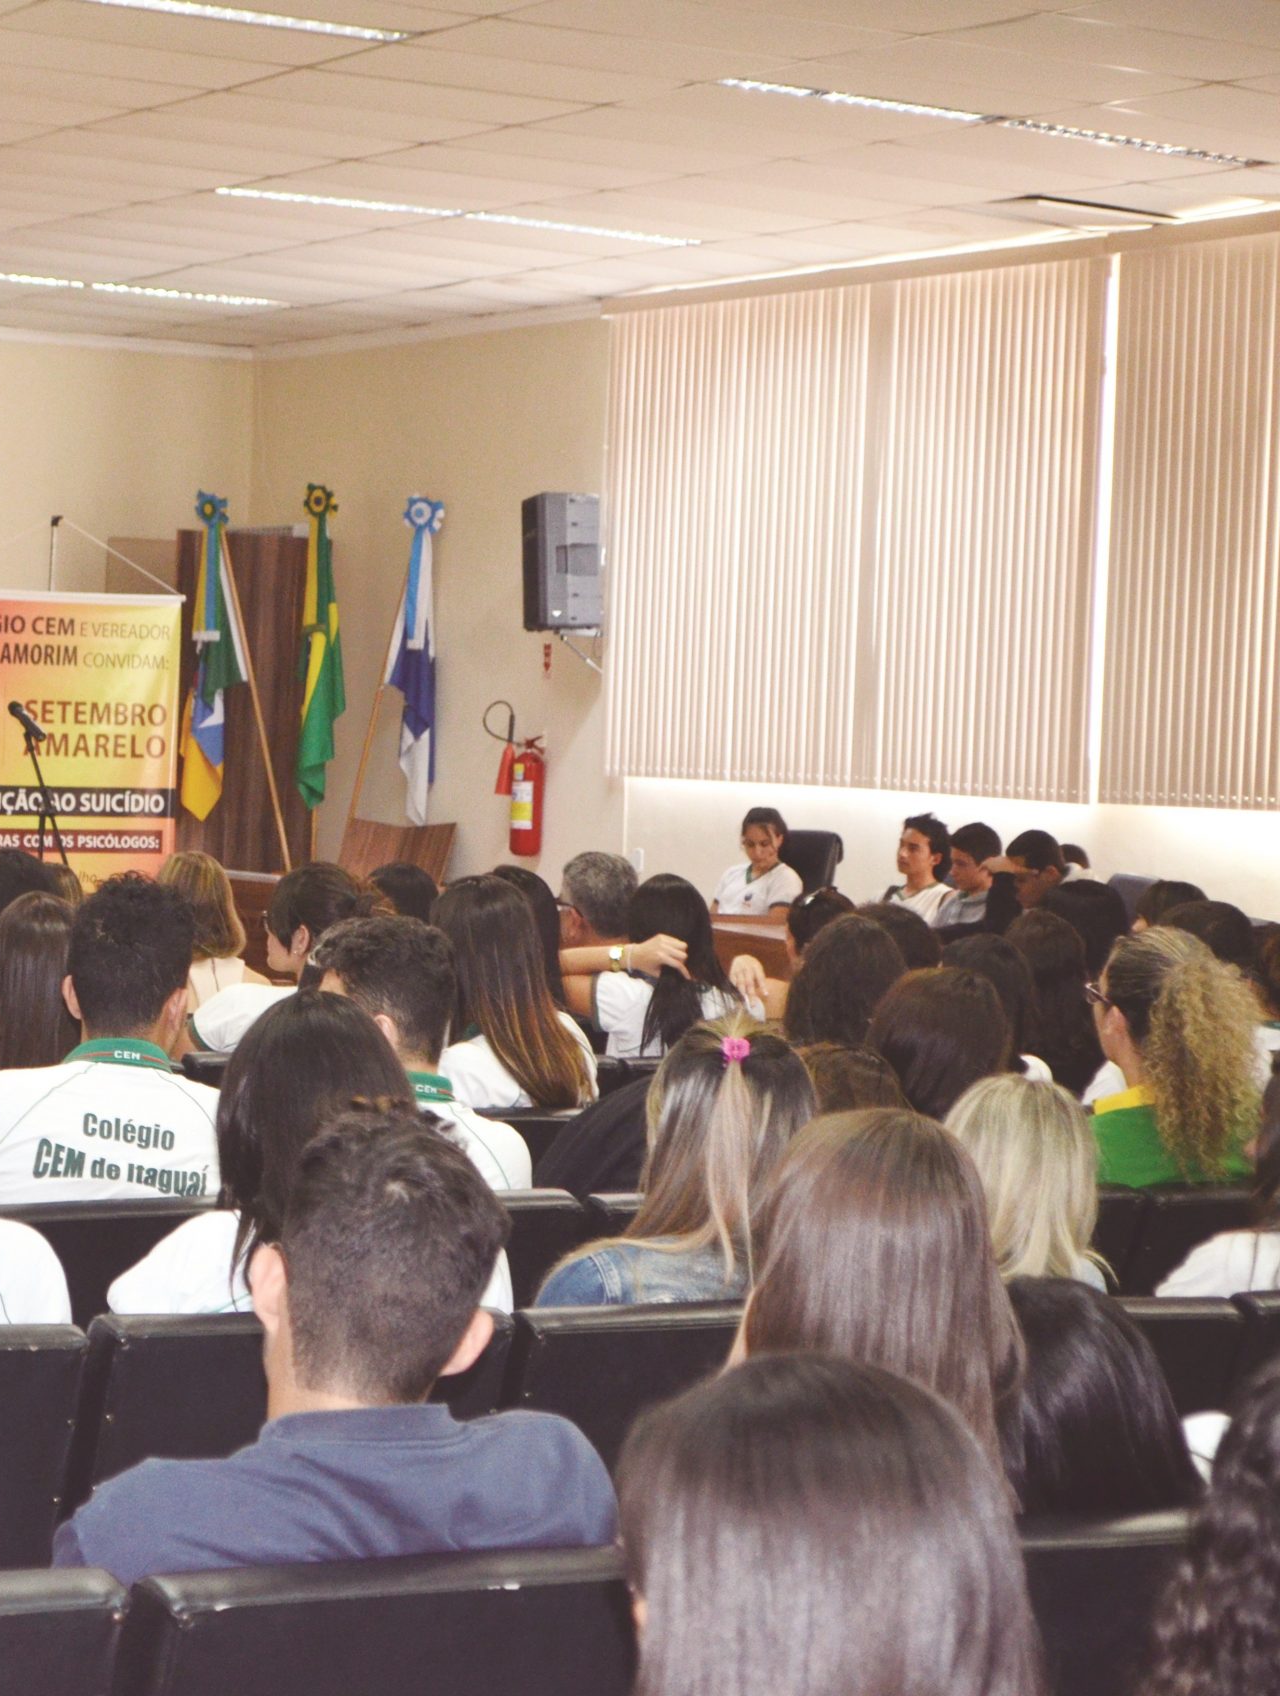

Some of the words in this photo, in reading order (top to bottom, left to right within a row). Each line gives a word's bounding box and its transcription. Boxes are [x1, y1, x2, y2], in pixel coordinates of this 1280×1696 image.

[31, 616, 76, 636] CEM
[80, 622, 88, 637] E
[92, 622, 170, 640] VEREADOR
[0, 643, 78, 666] AMORIM
[83, 652, 169, 670] CONVIDAM:
[22, 700, 167, 727] SETEMBRO
[23, 733, 166, 759] AMARELO
[50, 793, 76, 812] AO
[80, 791, 165, 813] SUICÍDIO
[23, 834, 53, 848] COM
[78, 833, 160, 849] PSICÓLOGOS:
[113, 1050, 141, 1061] CEM
[415, 1084, 438, 1094] CEM
[83, 1112, 175, 1151] Colégio
[32, 1138, 86, 1179] CEM
[90, 1157, 121, 1180] de
[126, 1163, 210, 1197] Itaguaí
